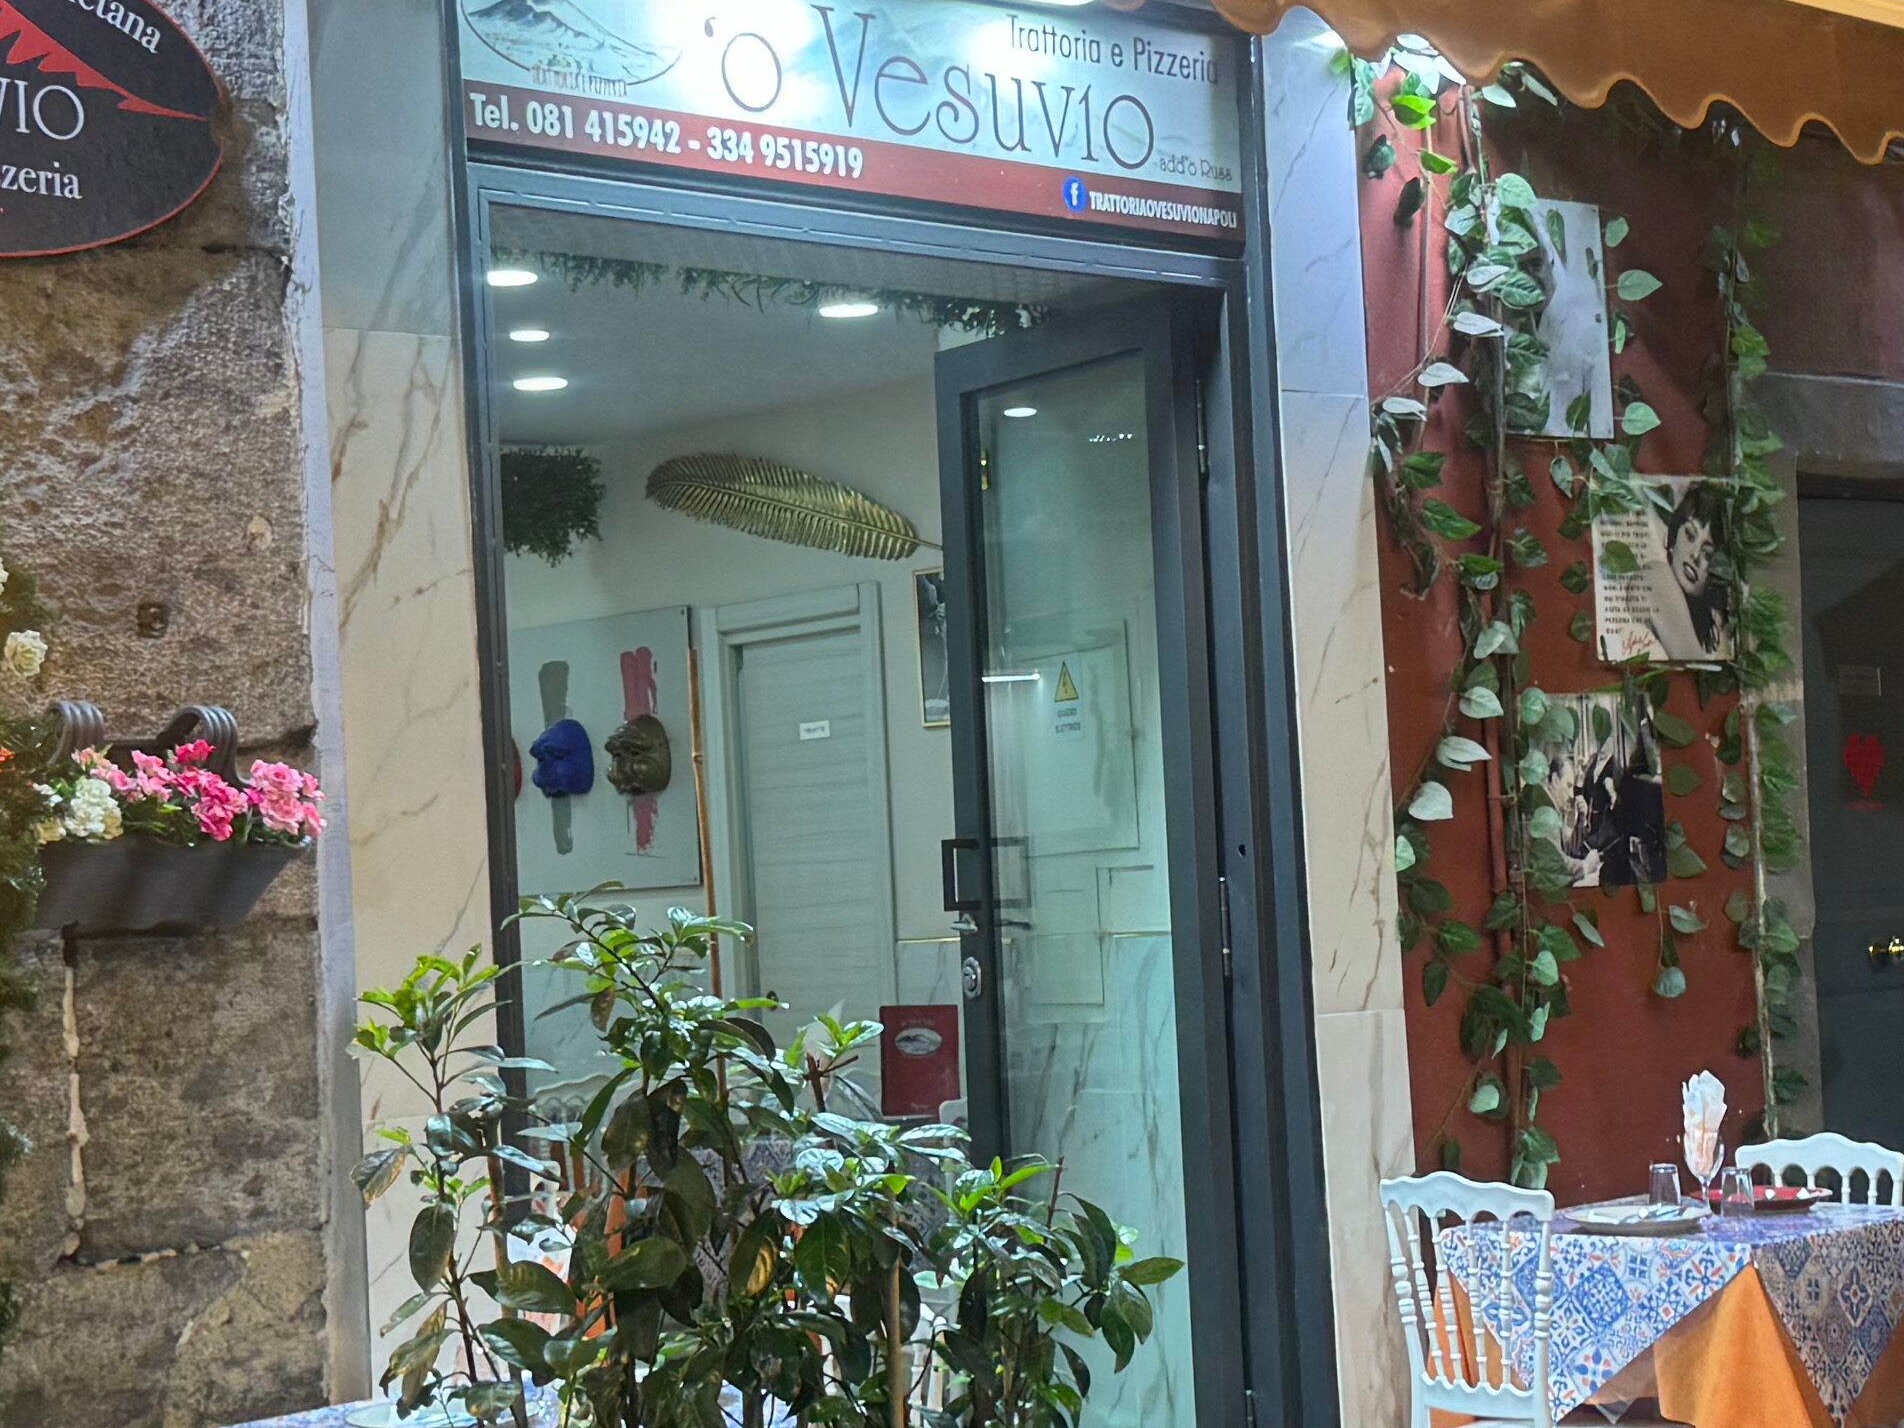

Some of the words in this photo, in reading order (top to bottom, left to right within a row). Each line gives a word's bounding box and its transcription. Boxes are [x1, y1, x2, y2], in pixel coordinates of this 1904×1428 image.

[810, 3, 1155, 170] Vesuvio
[1006, 13, 1102, 64] Trattoria
[1111, 42, 1124, 68] e
[1133, 36, 1219, 85] Pizzeria
[469, 92, 520, 132] Tel.
[526, 100, 575, 139] 081
[584, 108, 682, 155] 415942
[706, 126, 754, 165] 334
[759, 135, 865, 179] 9515919
[1089, 190, 1238, 229] TRATTORIAOVESUVIONAPOLI
